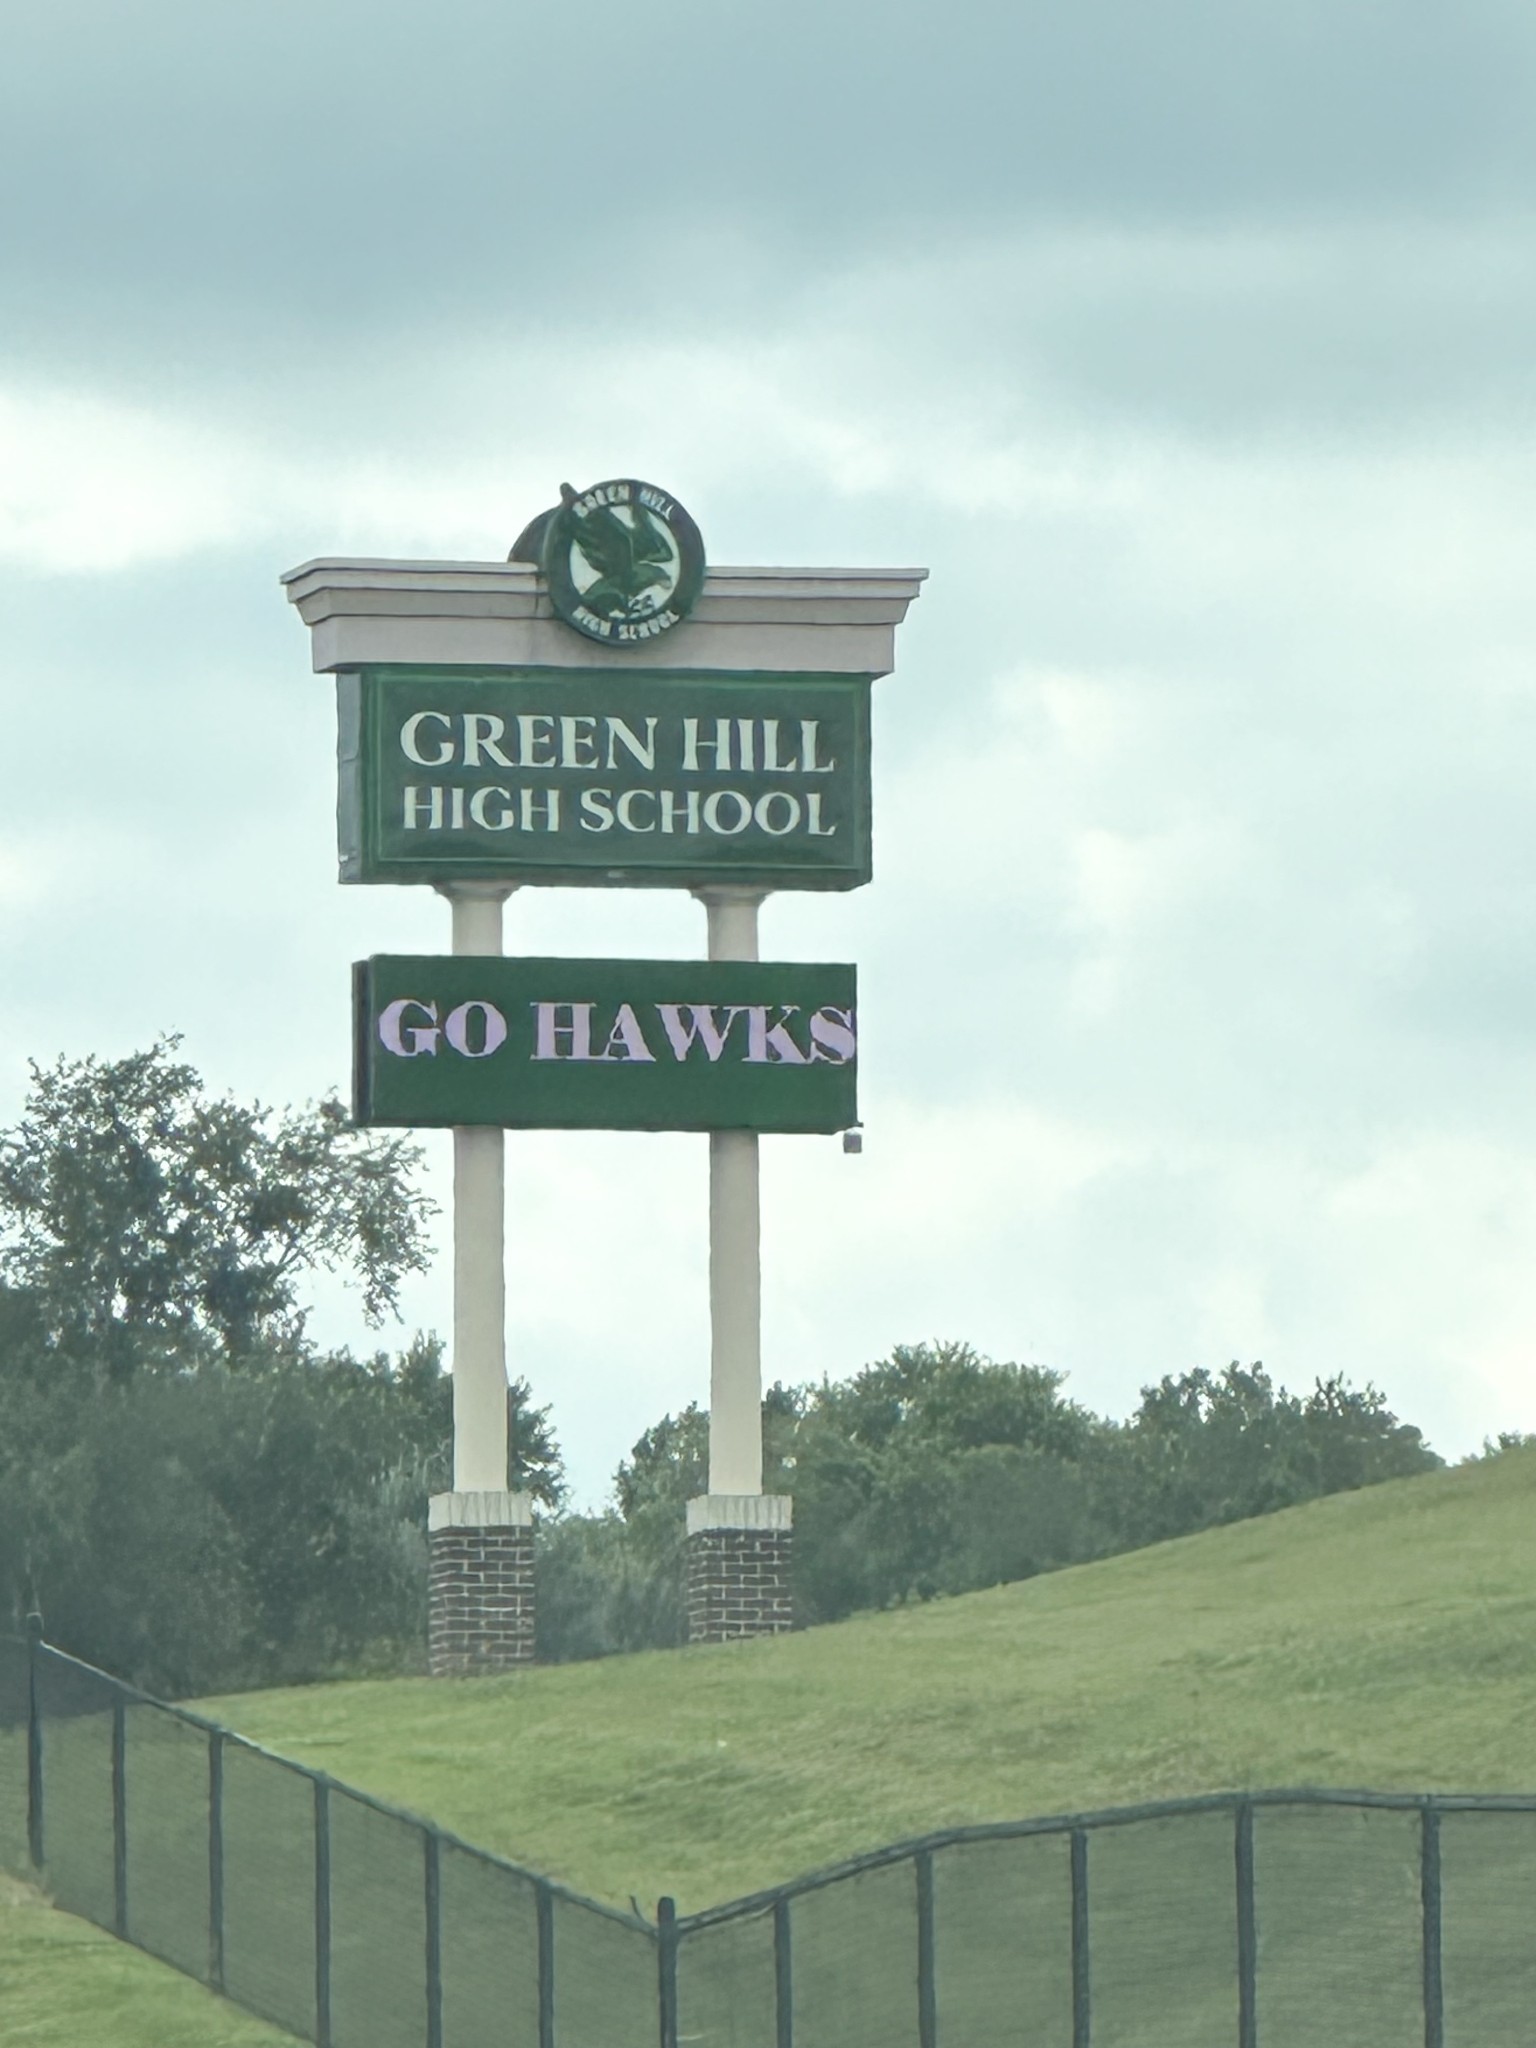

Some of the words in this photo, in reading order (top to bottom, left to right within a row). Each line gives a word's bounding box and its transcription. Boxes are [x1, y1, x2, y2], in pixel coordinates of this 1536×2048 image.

[400, 711, 658, 770] GREEN
[682, 718, 834, 773] HILL
[403, 786, 560, 832] HIGH
[579, 788, 836, 836] SCHOOL
[378, 999, 508, 1058] GO
[529, 1003, 856, 1065] HAWKS
